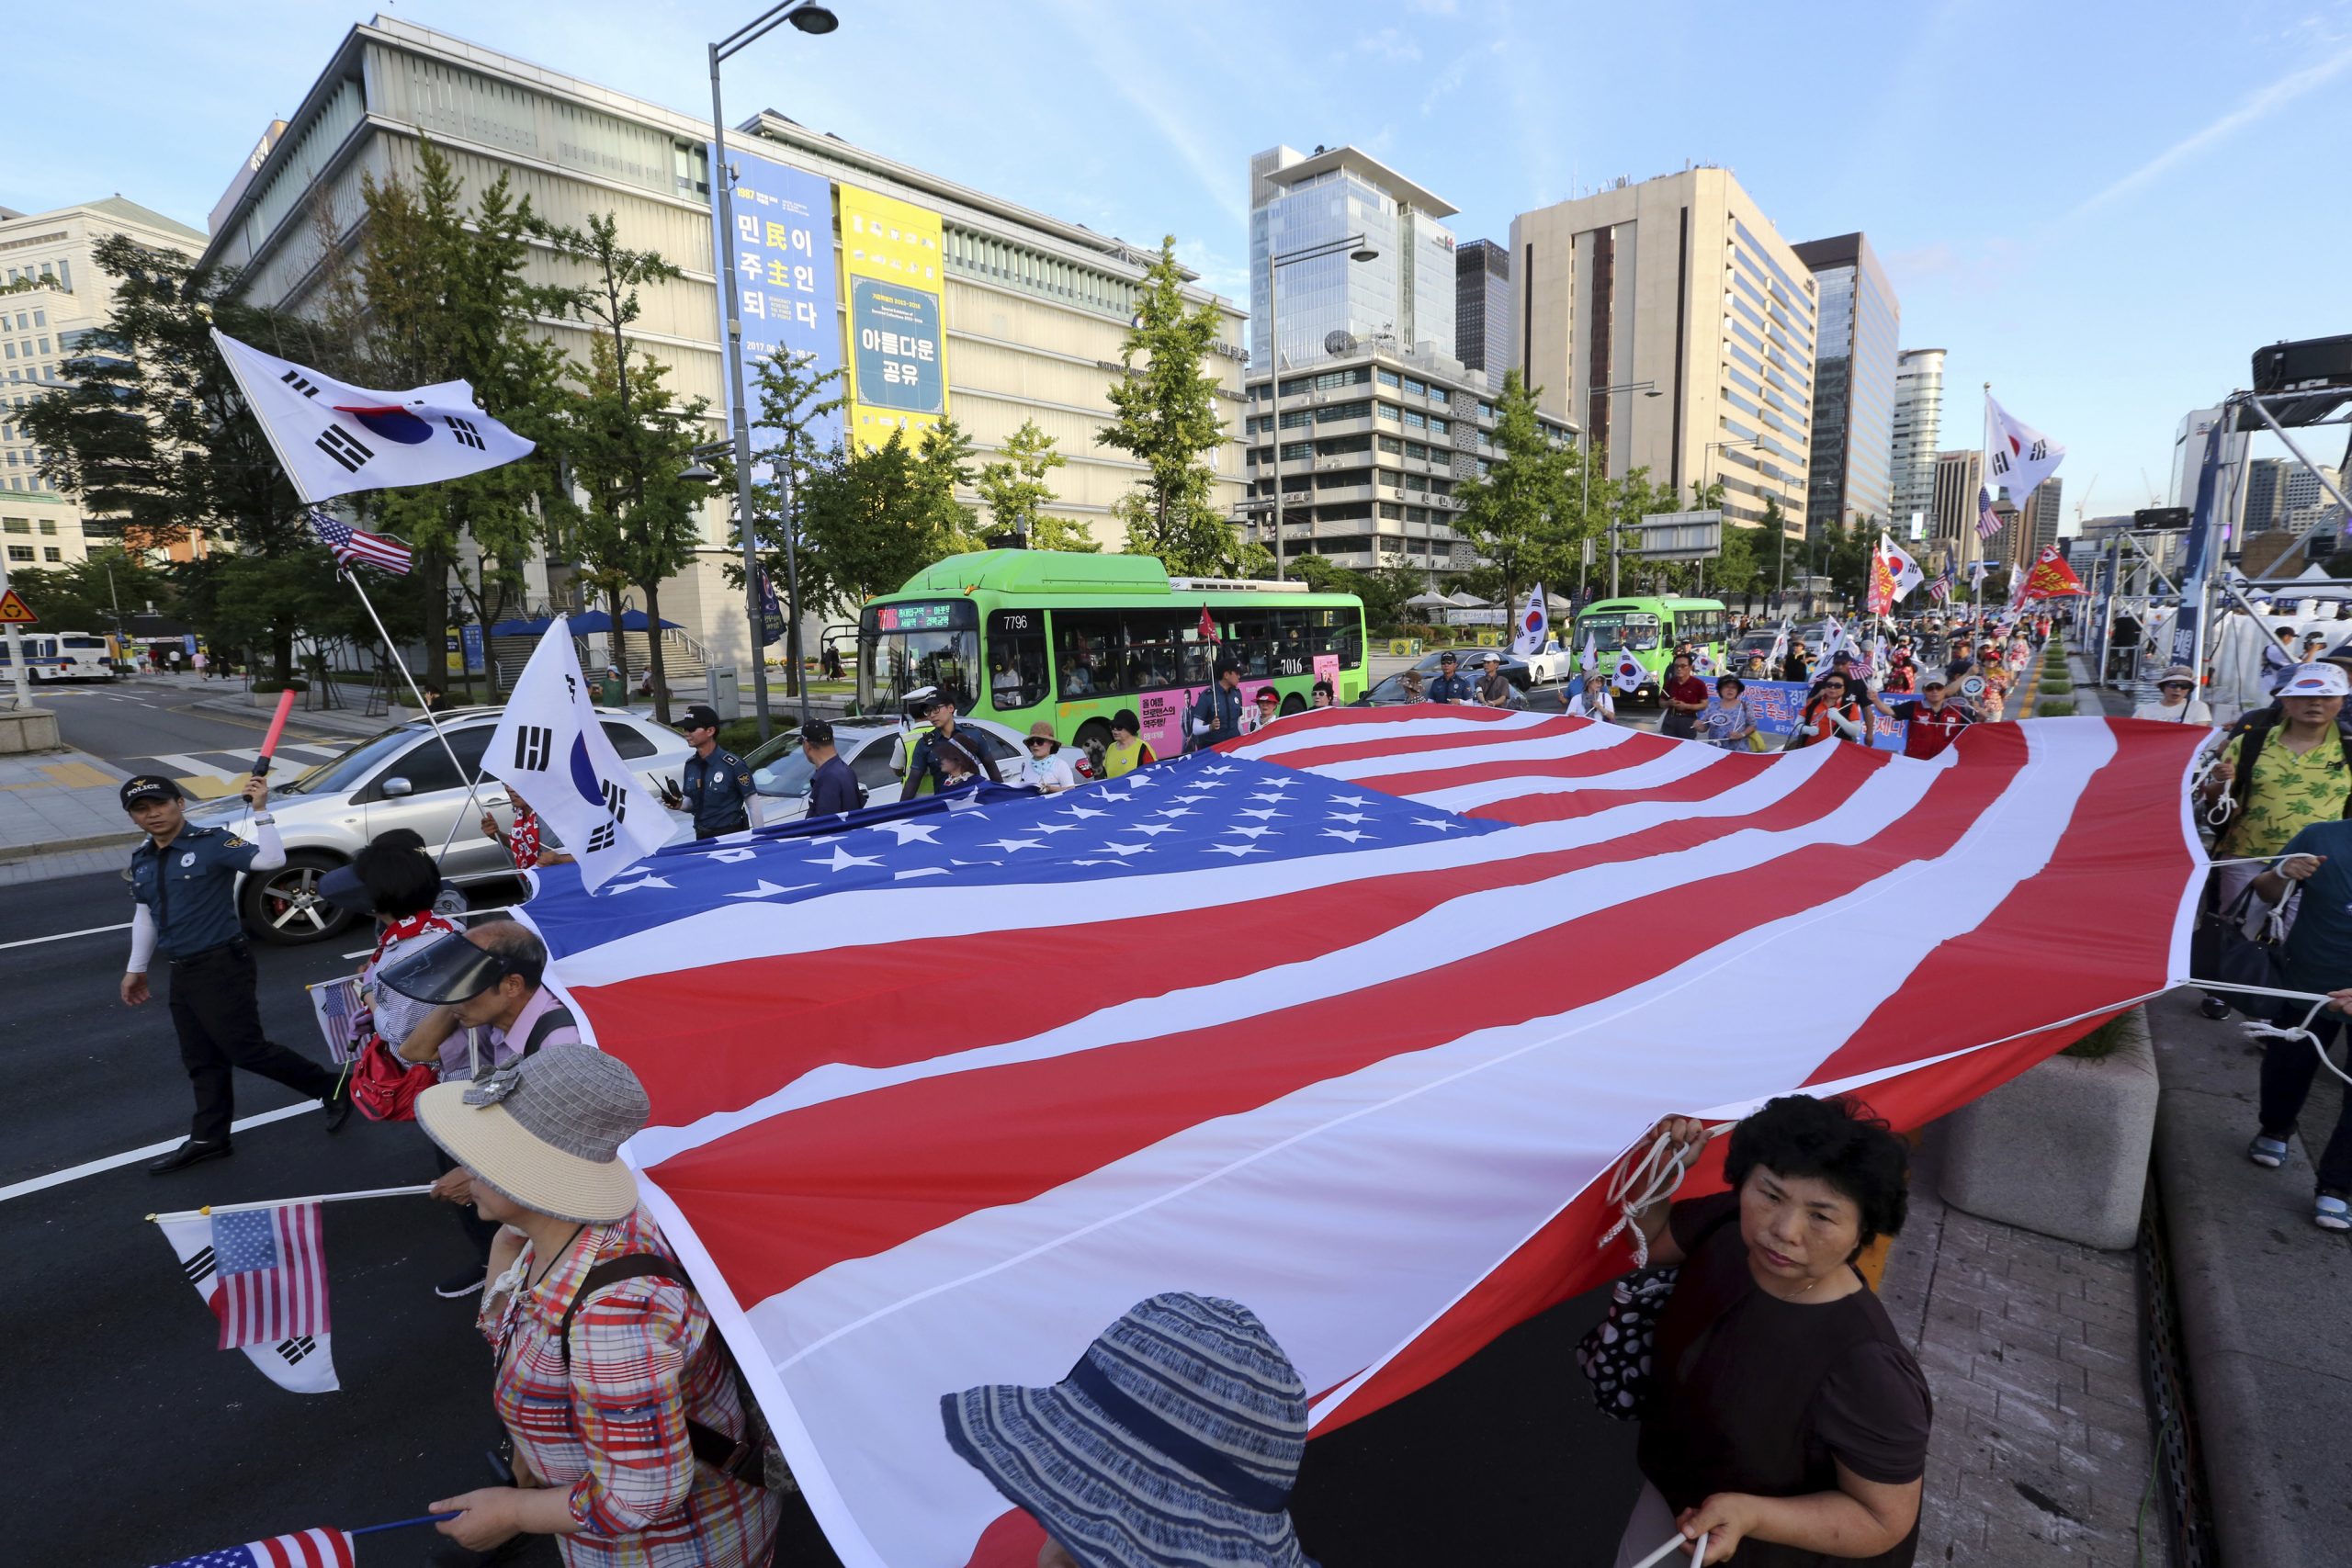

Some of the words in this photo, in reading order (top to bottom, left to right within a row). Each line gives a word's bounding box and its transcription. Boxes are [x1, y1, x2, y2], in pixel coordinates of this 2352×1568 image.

[737, 186, 754, 199] 1987
[863, 328, 934, 361] 아름다운
[883, 360, 918, 386] 공유
[1003, 615, 1027, 630] 7796
[1280, 658, 1303, 675] 7016
[1150, 697, 1164, 707] 여름
[1143, 706, 1176, 719] 브로맨스의
[1143, 717, 1166, 728] 역주행!
[126, 784, 161, 797] POLICE
